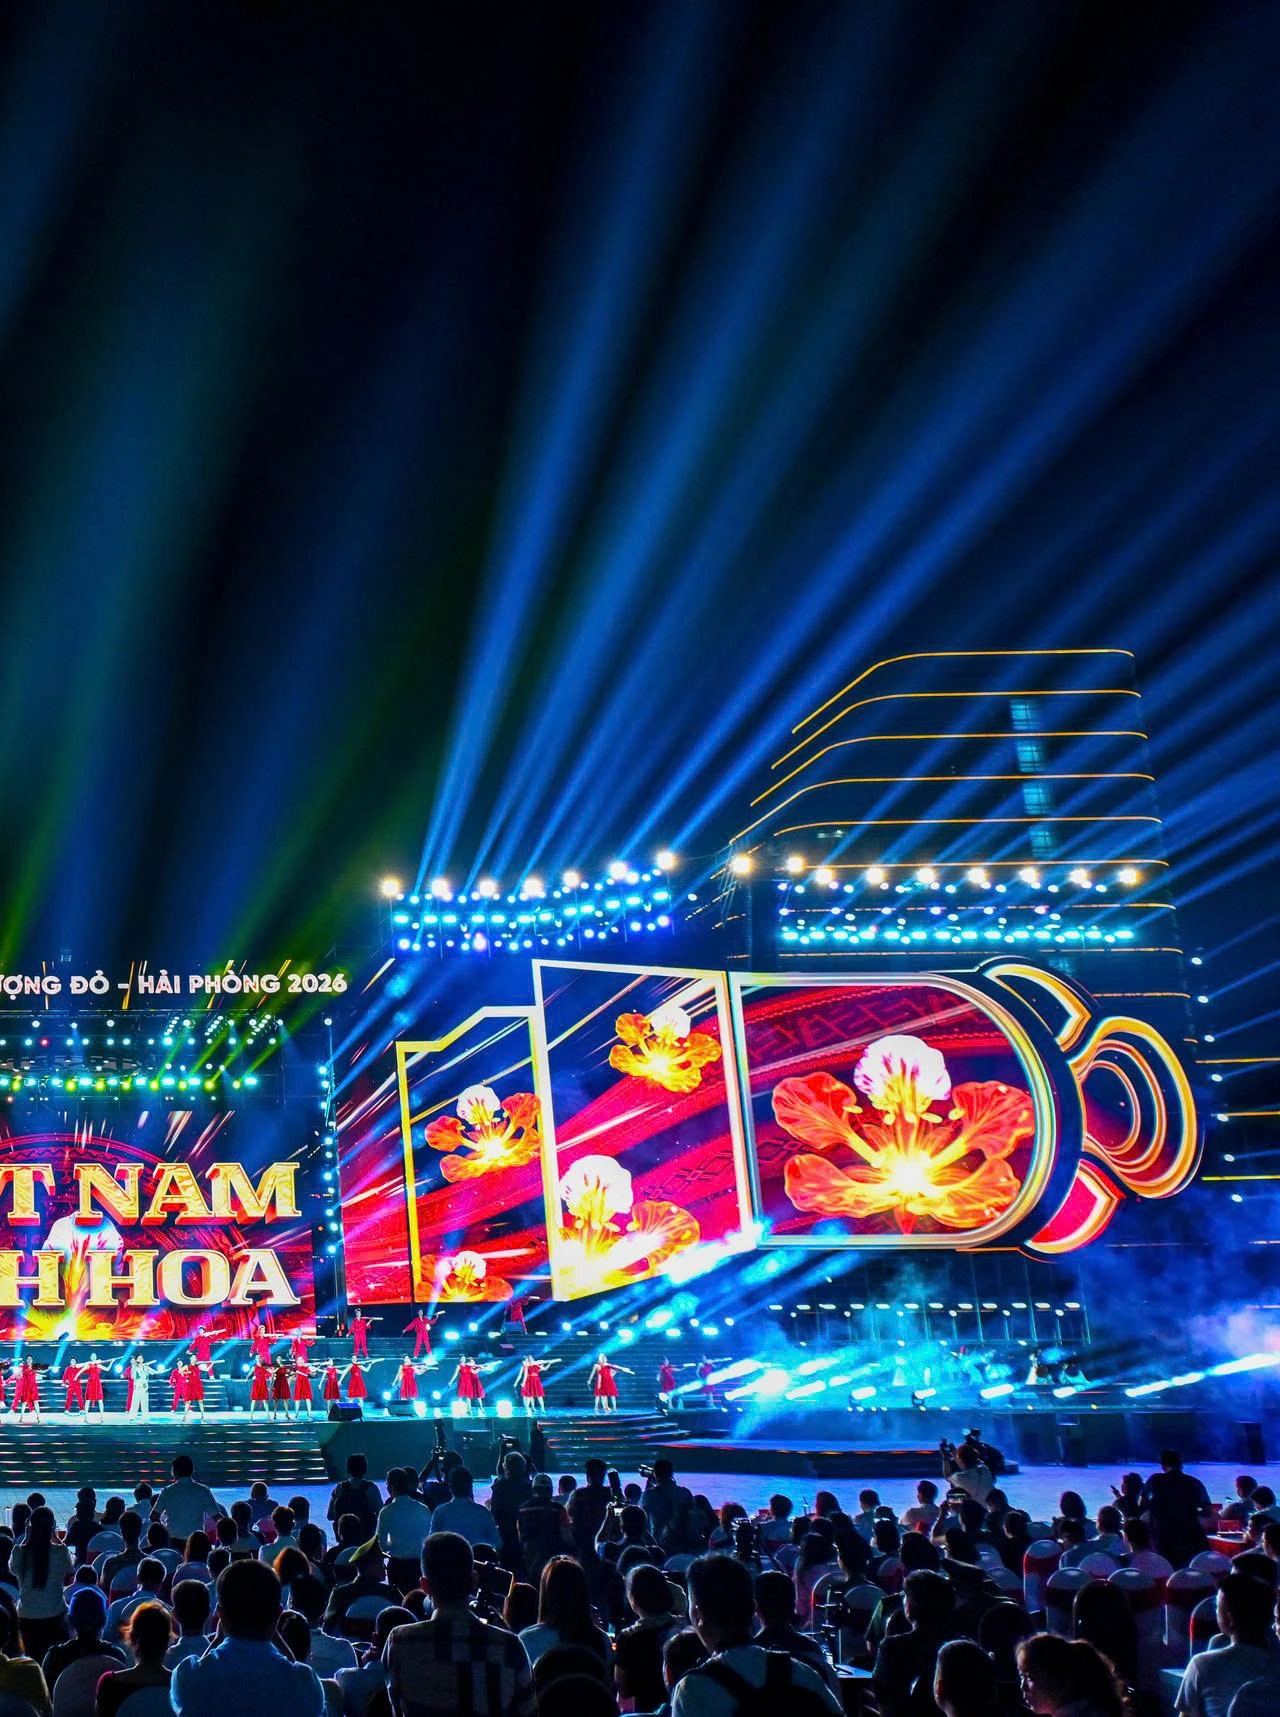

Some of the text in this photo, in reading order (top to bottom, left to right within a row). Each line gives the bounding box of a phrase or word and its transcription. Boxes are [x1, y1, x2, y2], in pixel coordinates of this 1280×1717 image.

[70, 970, 109, 995] ĐỎ
[139, 970, 180, 994] HẢI
[189, 971, 280, 993] PHÒNG
[288, 974, 347, 993] 2026
[74, 1162, 302, 1226] NAM
[85, 1249, 301, 1308] HOA
